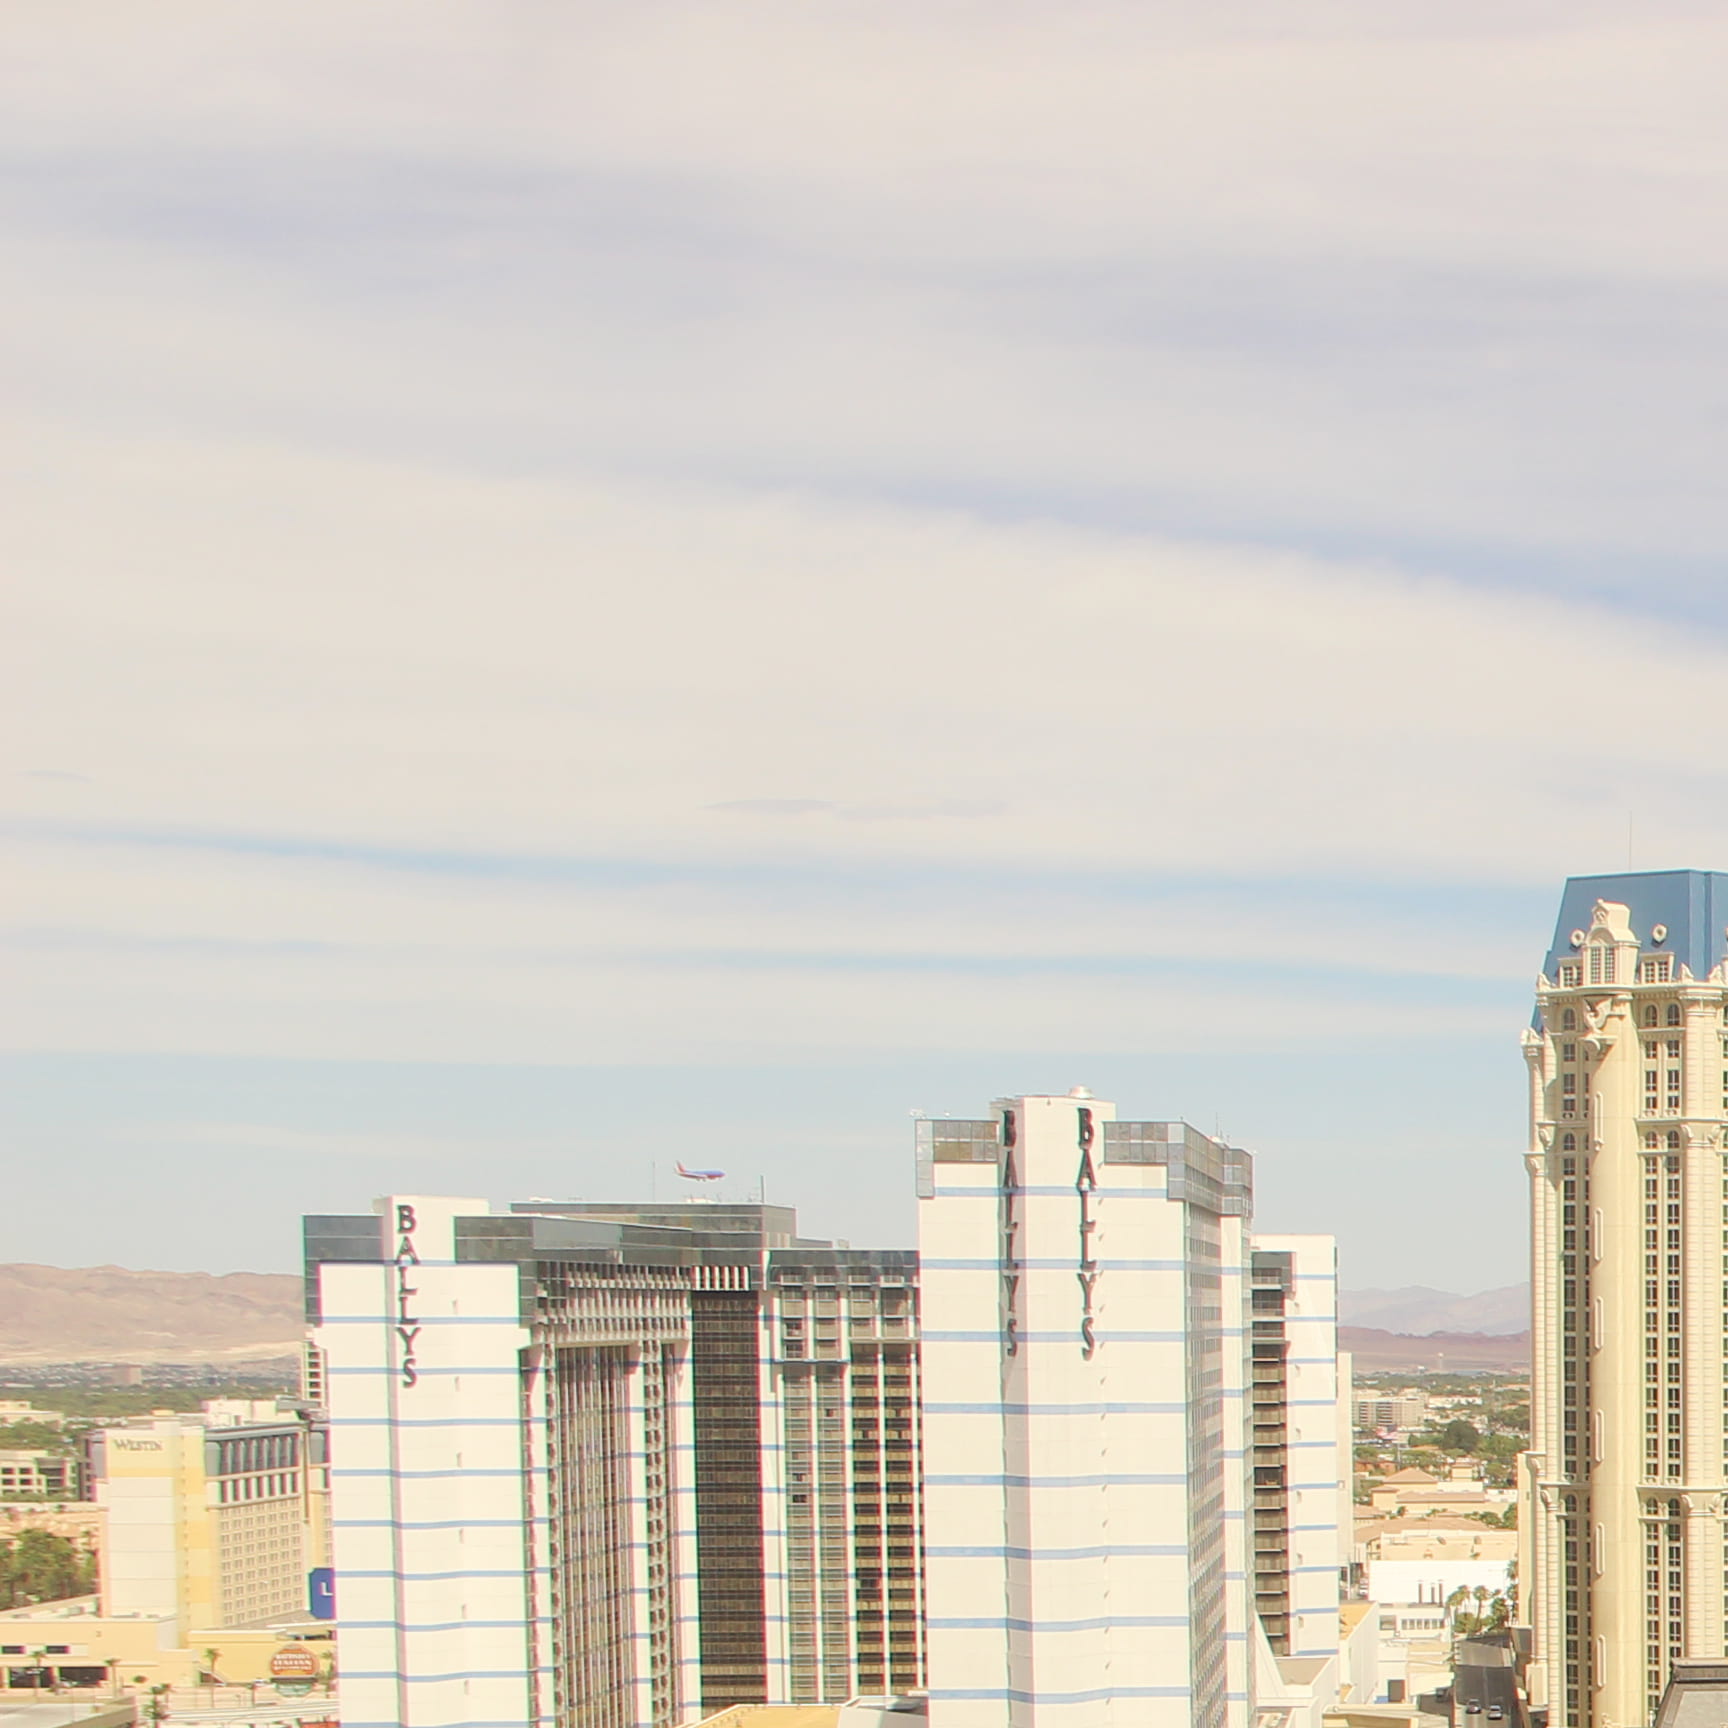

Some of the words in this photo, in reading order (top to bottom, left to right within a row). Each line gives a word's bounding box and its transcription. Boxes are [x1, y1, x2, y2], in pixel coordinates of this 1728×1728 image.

[395, 1205, 421, 1389] BALLYS
[1002, 1109, 1019, 1357] BALLYS
[1076, 1107, 1098, 1361] BALLYS
